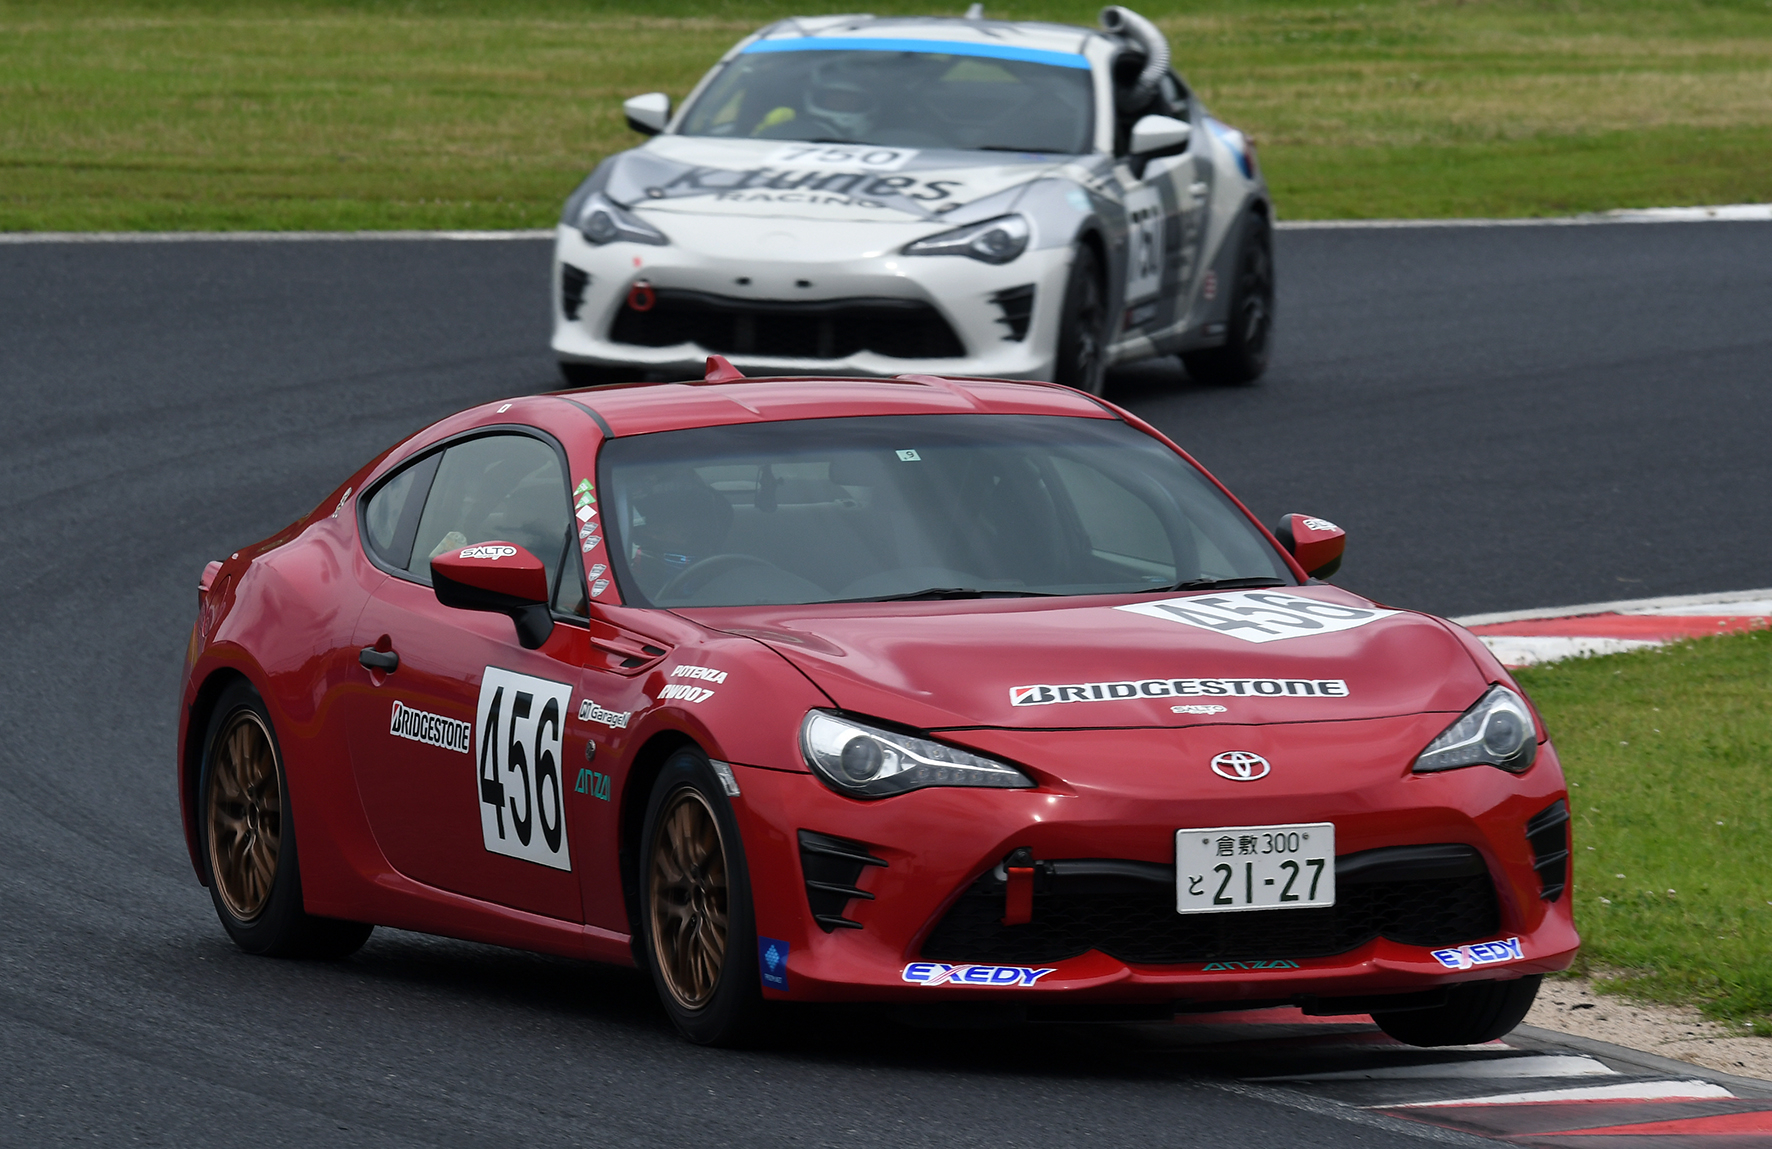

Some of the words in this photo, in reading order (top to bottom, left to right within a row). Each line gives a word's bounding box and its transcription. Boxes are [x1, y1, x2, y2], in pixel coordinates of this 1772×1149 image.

[782, 146, 901, 166] 750
[715, 190, 887, 209] RACING
[463, 547, 515, 556] SALTO
[1153, 593, 1375, 635] 456
[671, 665, 728, 684] POTENZA
[657, 684, 715, 704] RW007
[1016, 680, 1349, 705] BRIDGESTONE
[392, 704, 469, 751] BRIDGESTONE
[480, 686, 562, 853] 456
[1188, 875, 1204, 896] と
[1213, 859, 1325, 905] 21-27
[1436, 938, 1520, 967] EXEDY
[905, 963, 1051, 985] EXEDY
